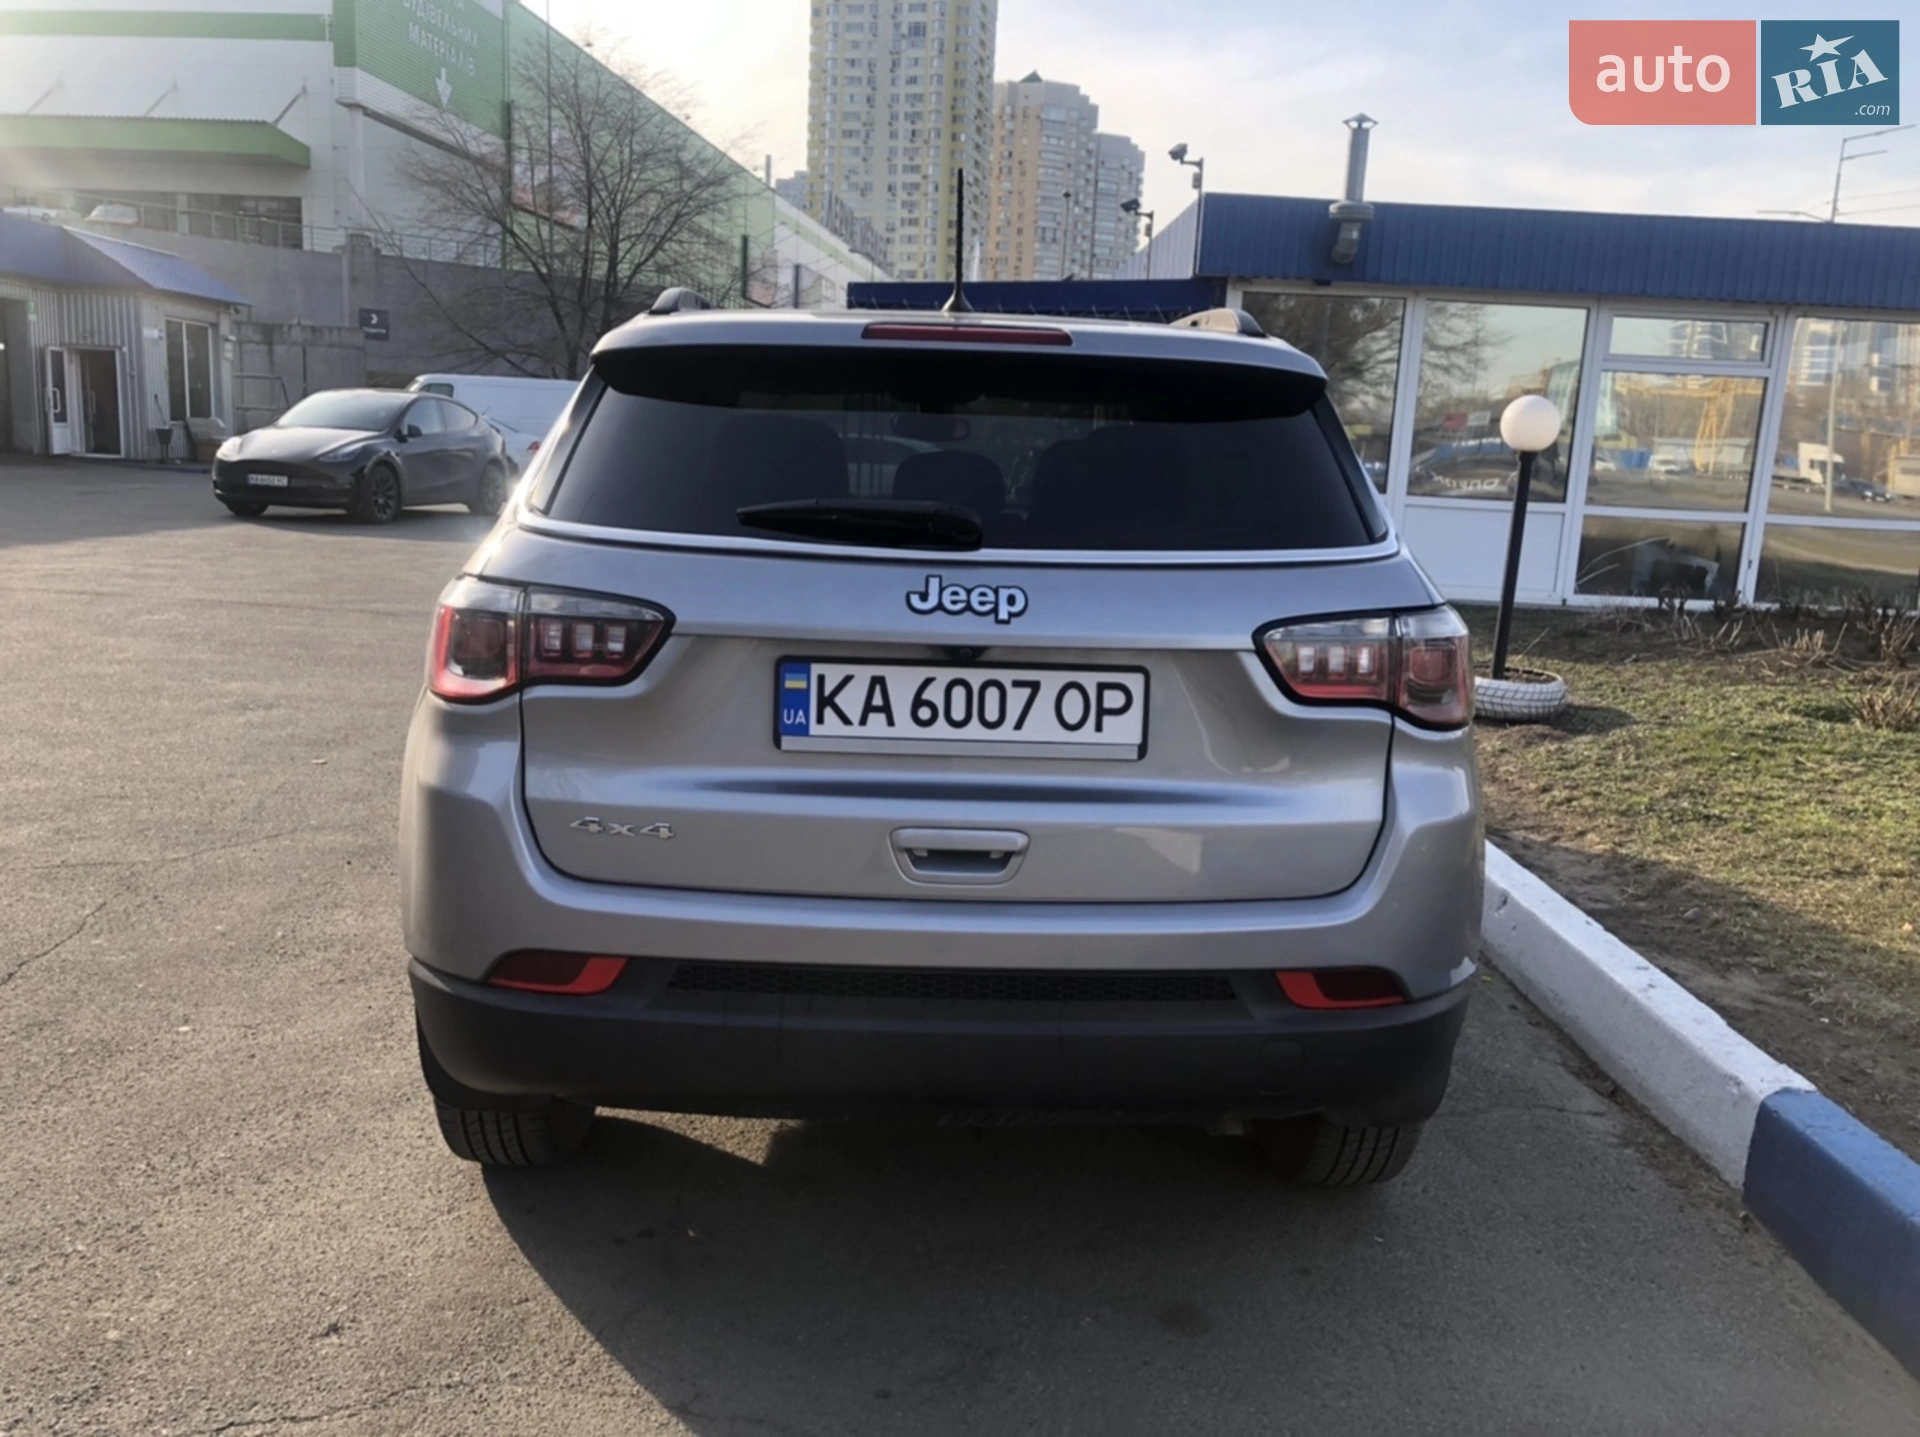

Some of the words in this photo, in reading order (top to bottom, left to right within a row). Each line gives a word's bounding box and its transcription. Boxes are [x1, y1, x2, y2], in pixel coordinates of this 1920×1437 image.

[906, 575, 1028, 624] Jeep
[783, 709, 807, 725] UA
[815, 673, 896, 728] KA
[910, 676, 1042, 731] 6007
[1054, 680, 1134, 733] OP
[569, 816, 676, 840] 4x4
